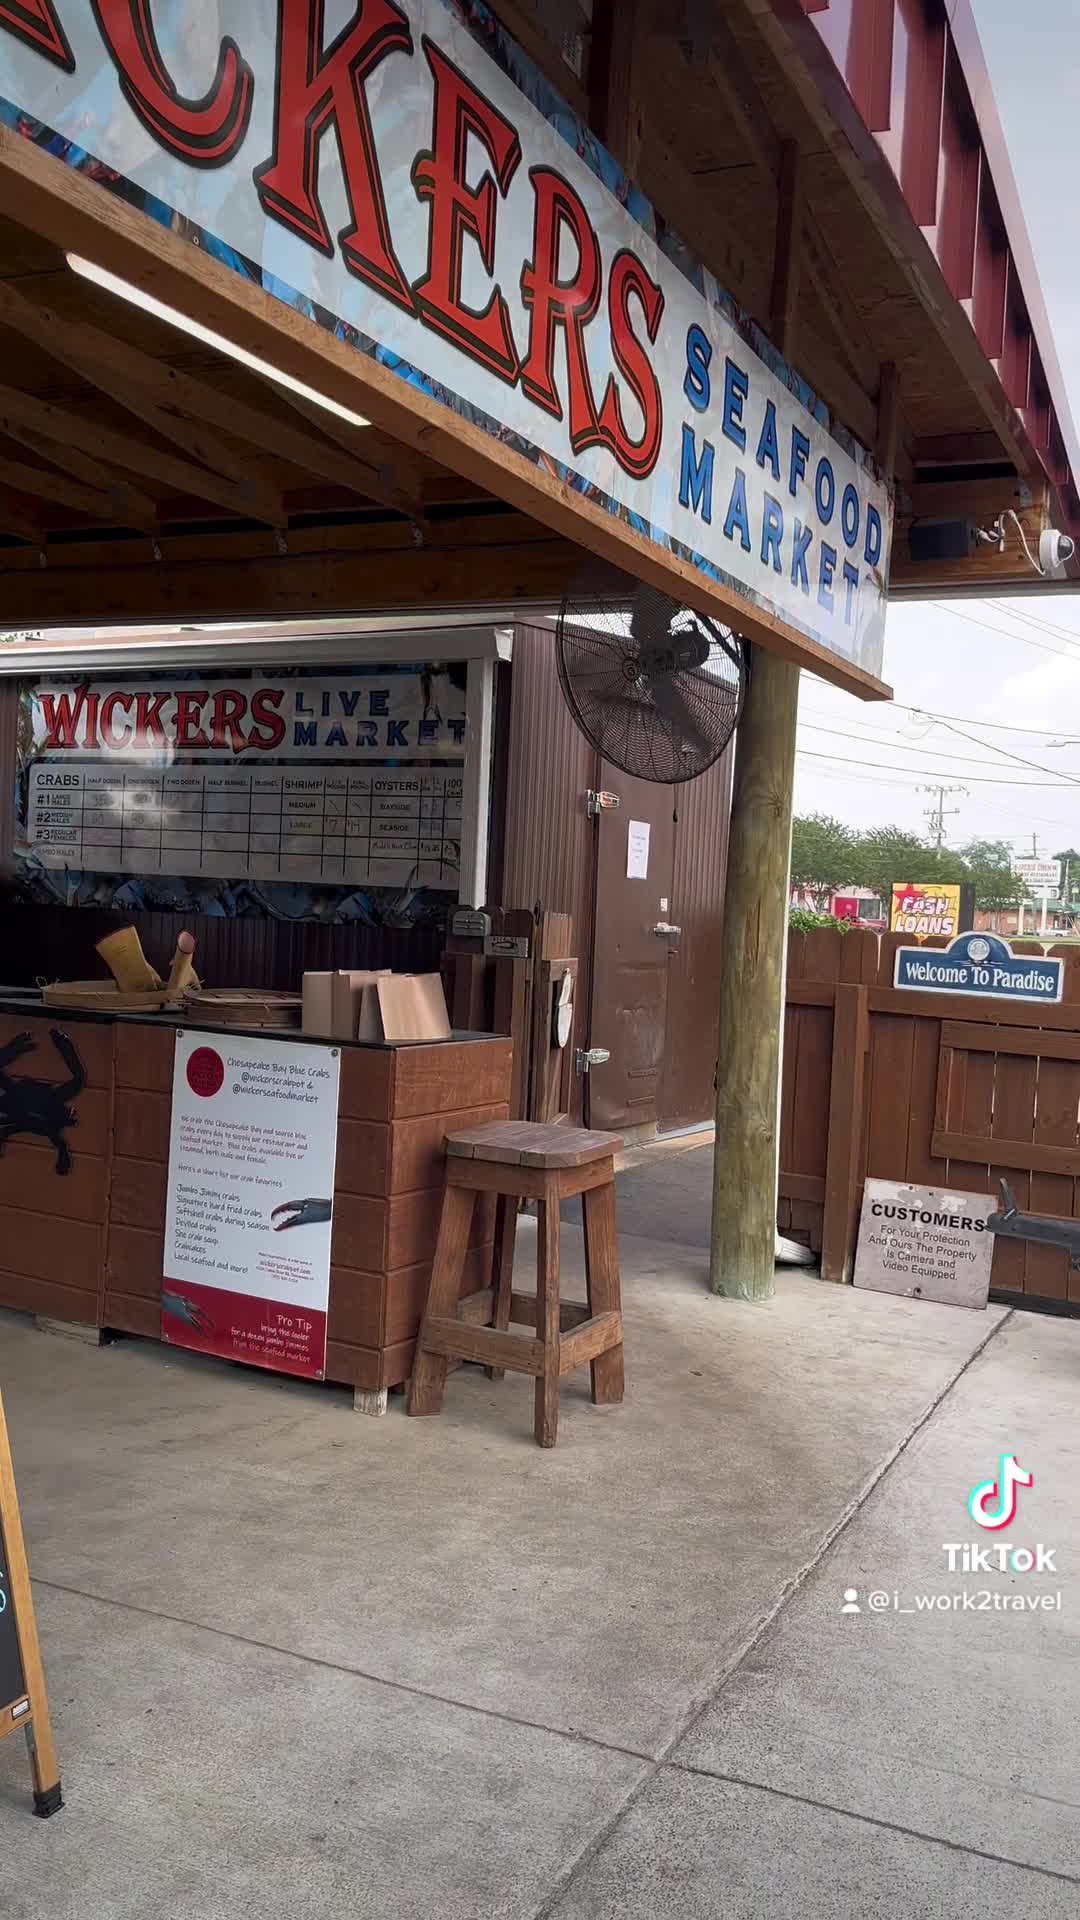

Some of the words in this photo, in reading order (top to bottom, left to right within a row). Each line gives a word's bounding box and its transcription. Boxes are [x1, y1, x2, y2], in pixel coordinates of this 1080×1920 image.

[683, 322, 882, 568] SEAFOOD
[678, 422, 860, 625] MARKET
[295, 689, 390, 716] LIVE
[39, 679, 286, 754] WICKERS
[293, 719, 466, 746] MARKET
[36, 774, 80, 786] CRABS
[284, 780, 323, 790] SHRIMP
[374, 781, 419, 791] OYSTERS
[37, 793, 50, 805] #1
[289, 801, 316, 809] MEDIUM
[36, 811, 50, 823] #2
[36, 829, 50, 841] #3
[901, 895, 950, 917] CASH
[895, 915, 954, 936] LOANS
[906, 962, 967, 984] Welcome
[971, 965, 990, 985] To
[992, 969, 1054, 992] Paradise
[227, 1057, 270, 1070] Chesapeake
[272, 1063, 287, 1074] Bay
[289, 1065, 305, 1075] Blue
[308, 1068, 330, 1079] Crabs
[307, 1081, 314, 1089] &
[262, 1138, 296, 1147] restaurant
[177, 1183, 198, 1194] Jumbo
[222, 1192, 240, 1202] crabs
[177, 1195, 208, 1207] Signature
[209, 1201, 225, 1211] hard
[227, 1204, 242, 1214] fried
[244, 1208, 262, 1219] crabs
[176, 1206, 204, 1218] Softshell
[205, 1212, 223, 1223] crabs
[224, 1216, 245, 1229] during
[247, 1221, 270, 1231] season
[871, 1203, 985, 1232] CUSTOMERS
[199, 1222, 217, 1233] crabs
[880, 1224, 897, 1235] For
[898, 1227, 921, 1239] Your
[922, 1231, 970, 1247] Protection
[188, 1232, 202, 1241] crab
[203, 1236, 219, 1245] soup
[868, 1235, 888, 1246] And
[890, 1238, 913, 1250] Ours
[916, 1242, 934, 1254] The
[936, 1246, 977, 1262] Property
[191, 1256, 215, 1267] seafood
[216, 1261, 228, 1270] and
[886, 1250, 895, 1259] Is
[897, 1251, 935, 1267] Camera
[937, 1258, 956, 1269] and
[882, 1260, 909, 1273] Video
[911, 1264, 957, 1281] Equipped.
[231, 1326, 241, 1335] for
[261, 1321, 277, 1336] bring
[291, 1331, 310, 1341] cooler
[276, 1314, 293, 1327] Pro
[295, 1318, 313, 1333] Tip
